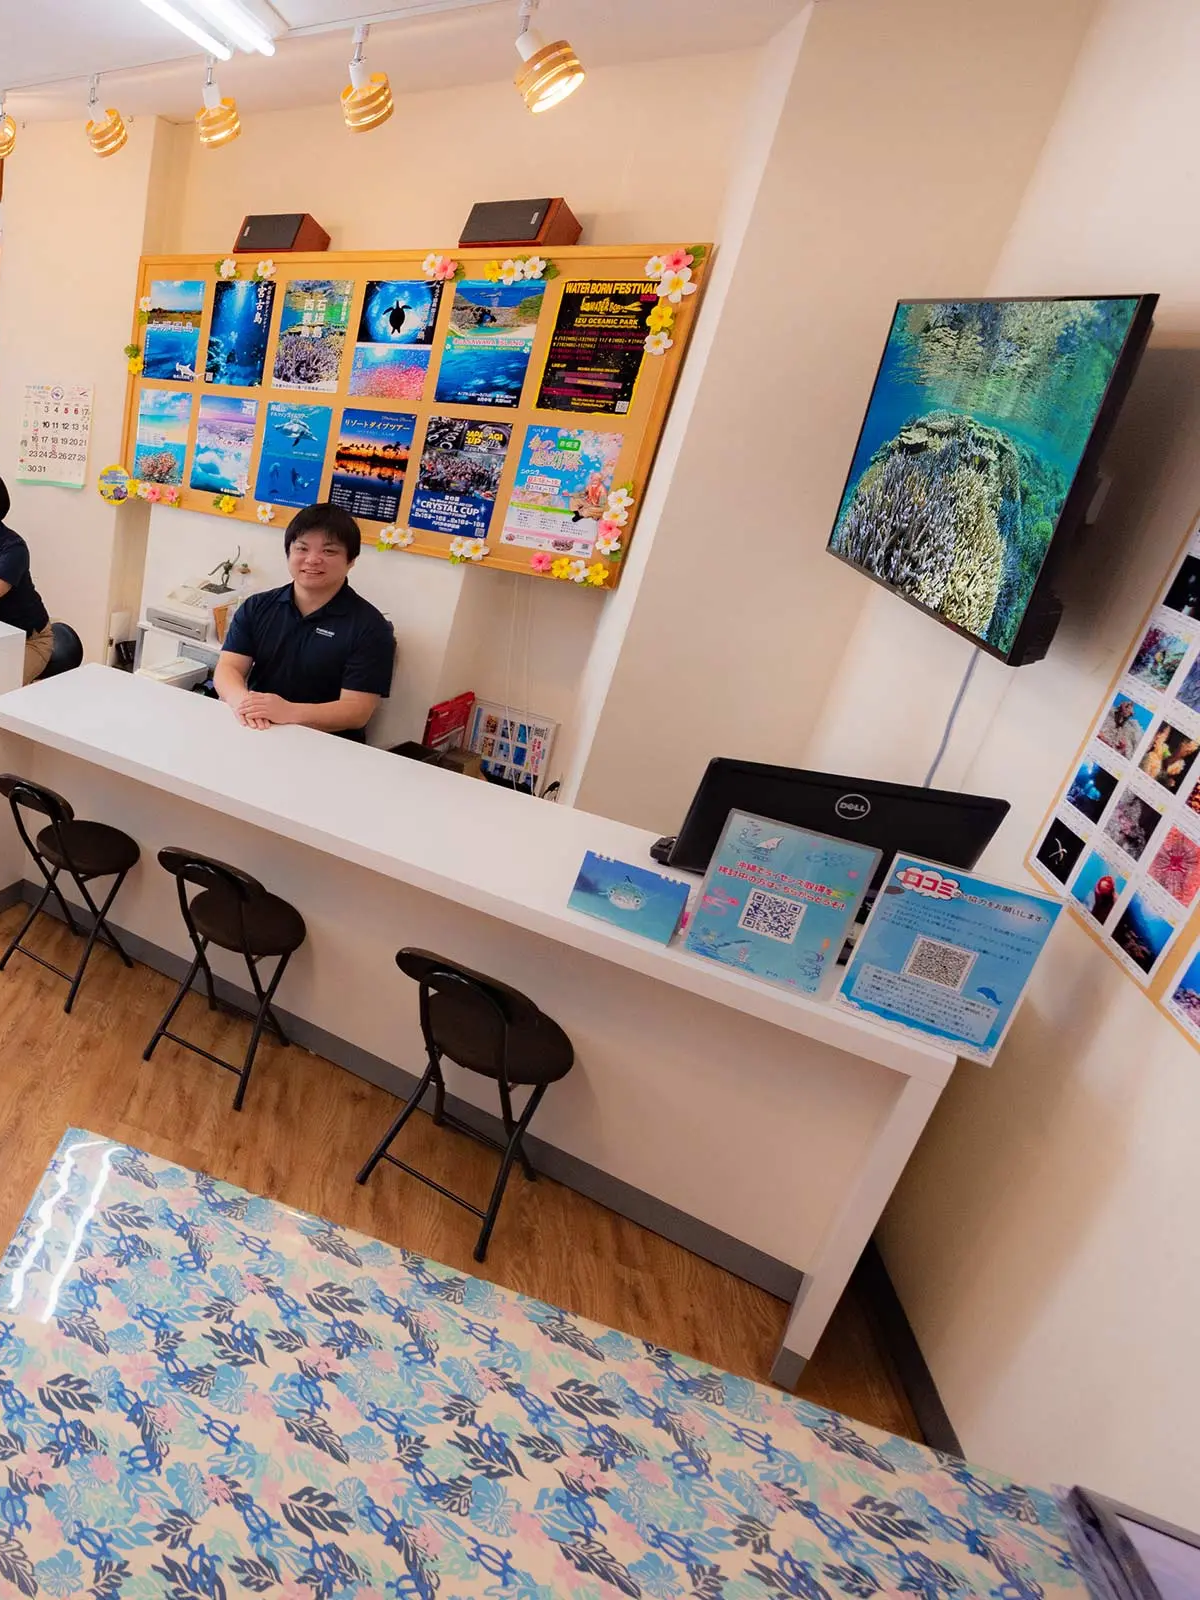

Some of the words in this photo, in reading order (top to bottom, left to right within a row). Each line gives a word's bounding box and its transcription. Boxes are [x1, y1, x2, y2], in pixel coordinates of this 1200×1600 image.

[565, 283, 590, 294] WATER
[590, 283, 614, 294] BORN
[613, 283, 659, 294] FESTIVAL
[253, 286, 267, 325] 宮古島
[575, 317, 587, 325] IZU
[74, 407, 79, 415] 6
[345, 419, 410, 431] リゾートダイブツアー
[60, 437, 68, 445] 19
[69, 438, 78, 446] 20
[29, 450, 38, 458] 23
[58, 452, 67, 460] 26
[67, 453, 77, 461] 27
[28, 464, 37, 472] 30
[420, 500, 459, 513] CRYSTAL
[460, 506, 480, 516] CUP
[839, 802, 866, 813] DELL
